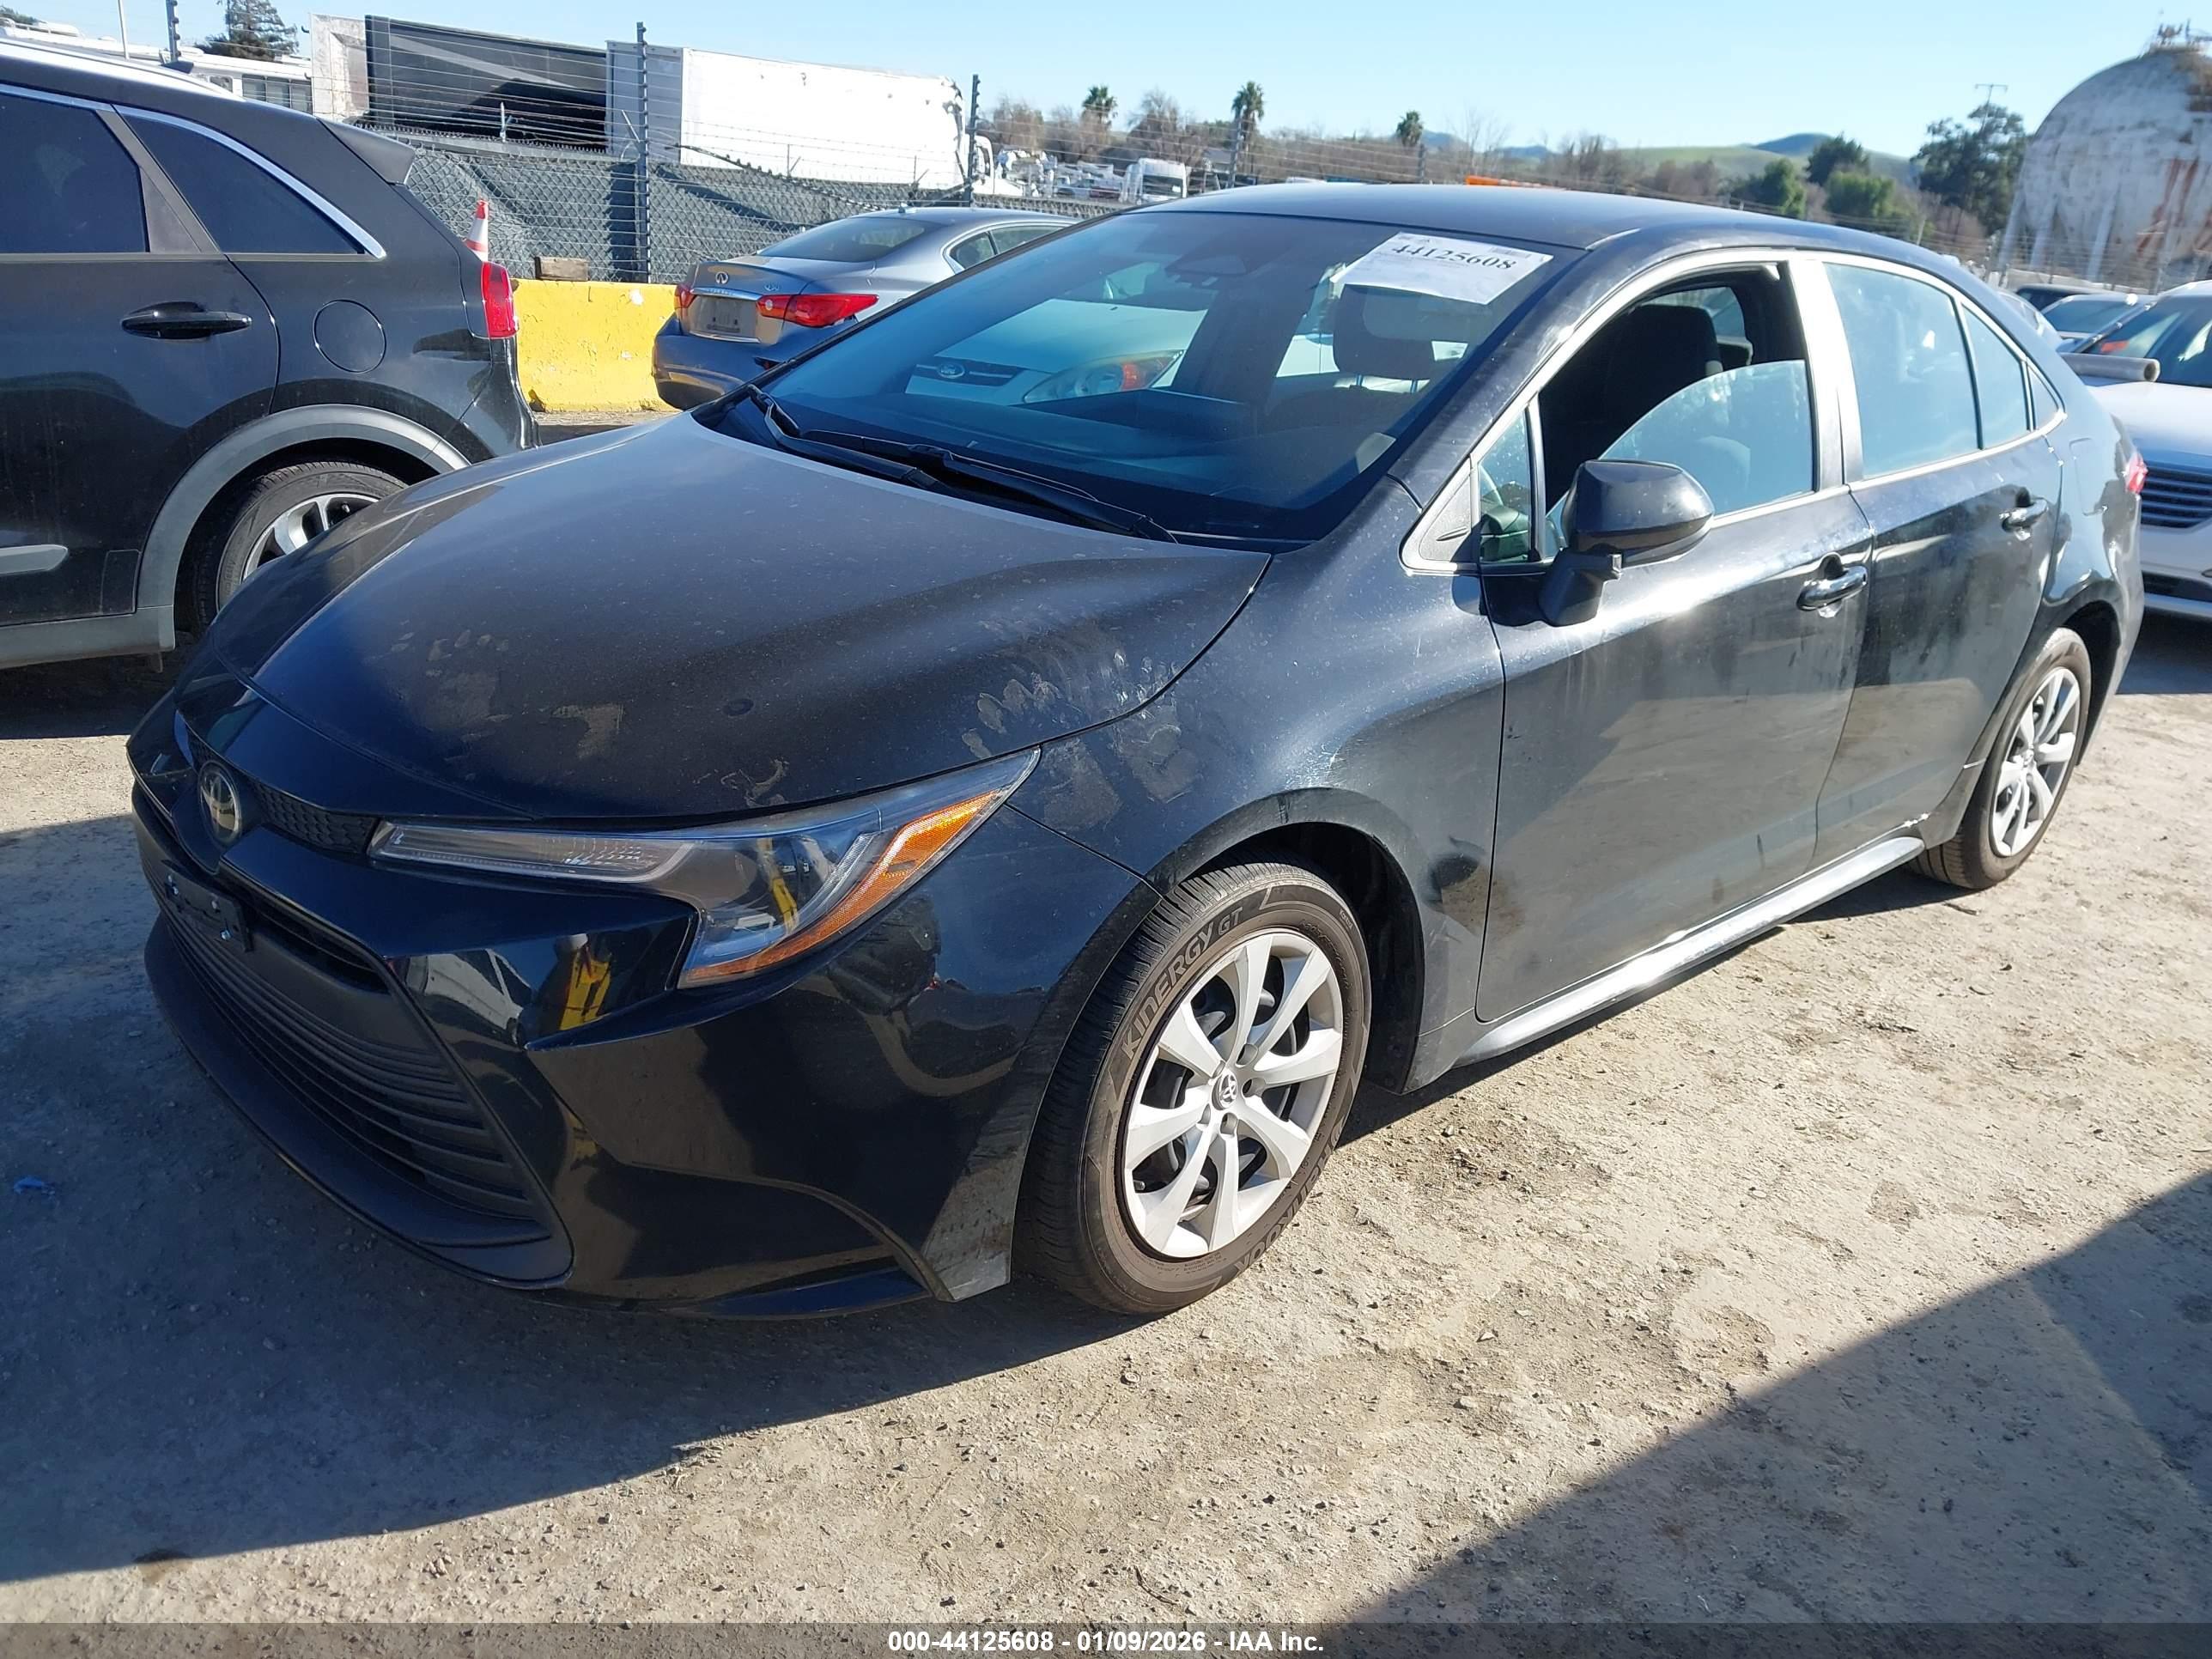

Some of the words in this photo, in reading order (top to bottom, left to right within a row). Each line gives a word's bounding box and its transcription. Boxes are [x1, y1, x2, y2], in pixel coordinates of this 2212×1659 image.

[1392, 245, 1516, 270] 44125608
[1121, 921, 1214, 1060] KINERGY
[1218, 906, 1243, 936] GT
